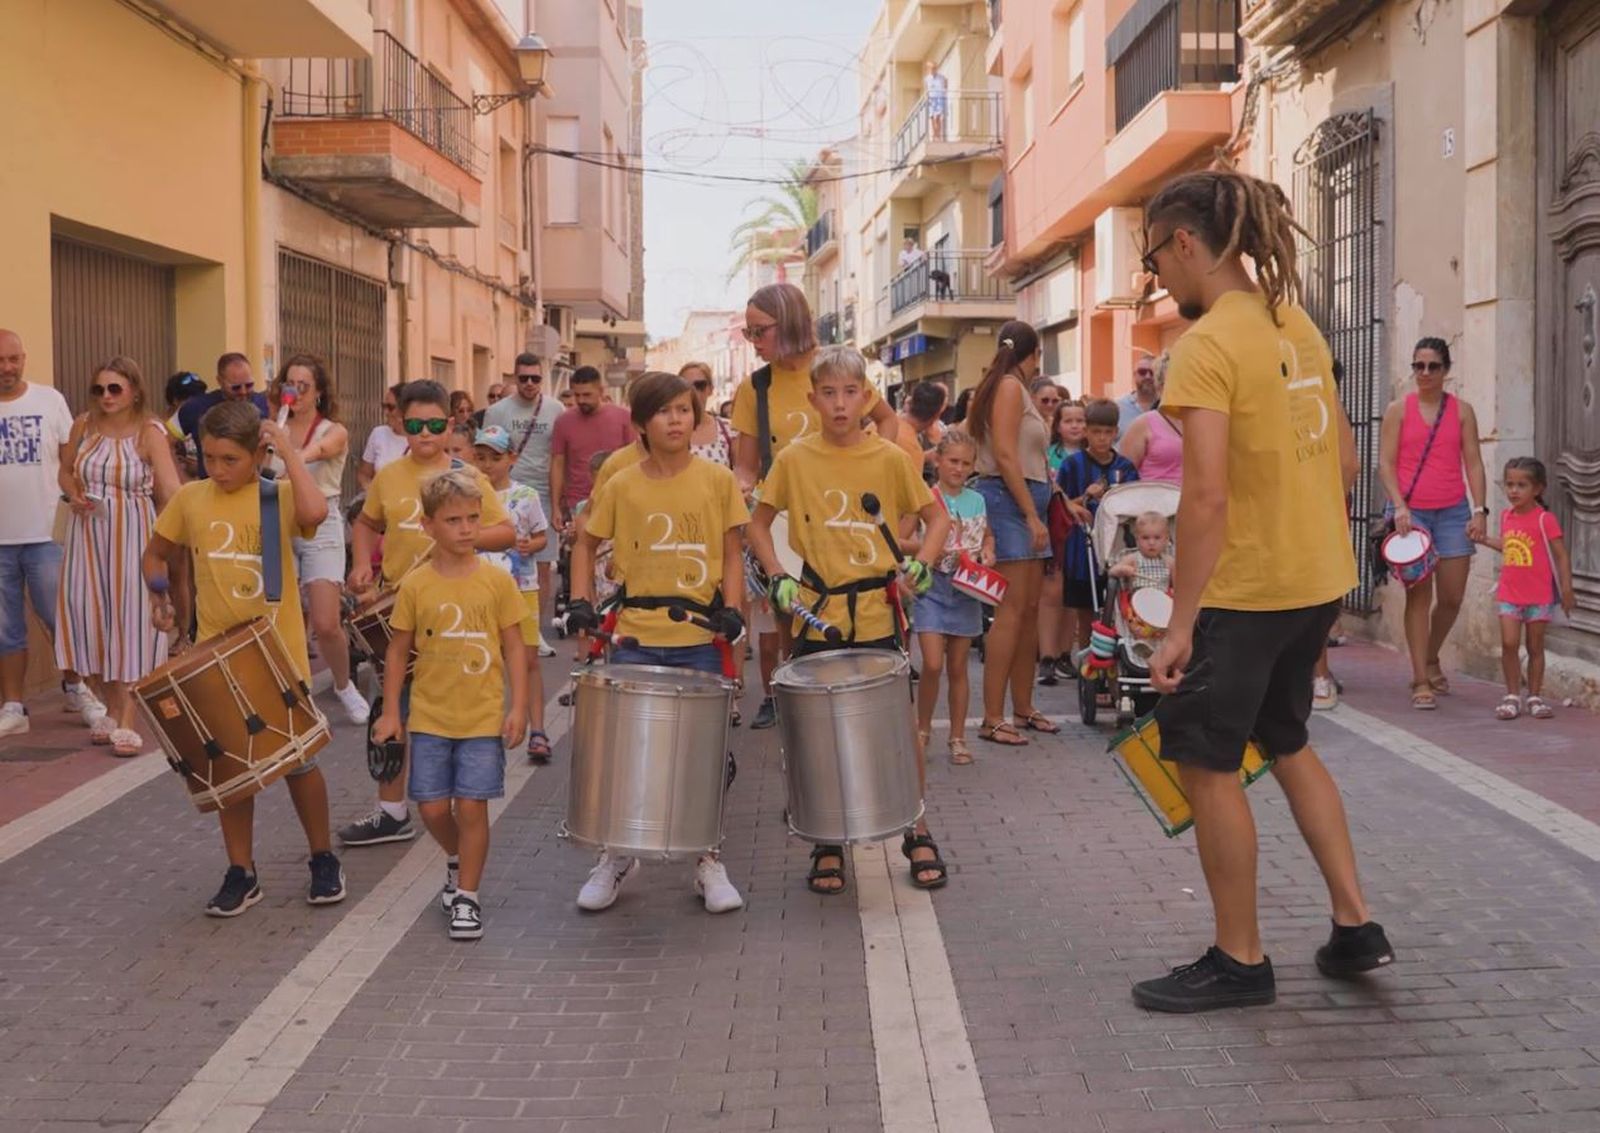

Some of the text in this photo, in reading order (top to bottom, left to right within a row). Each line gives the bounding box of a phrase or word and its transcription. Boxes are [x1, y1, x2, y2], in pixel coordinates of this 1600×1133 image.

[0, 438, 41, 465] ACH
[647, 512, 707, 589] 25
[824, 489, 877, 566] 25
[439, 602, 492, 676] 25
